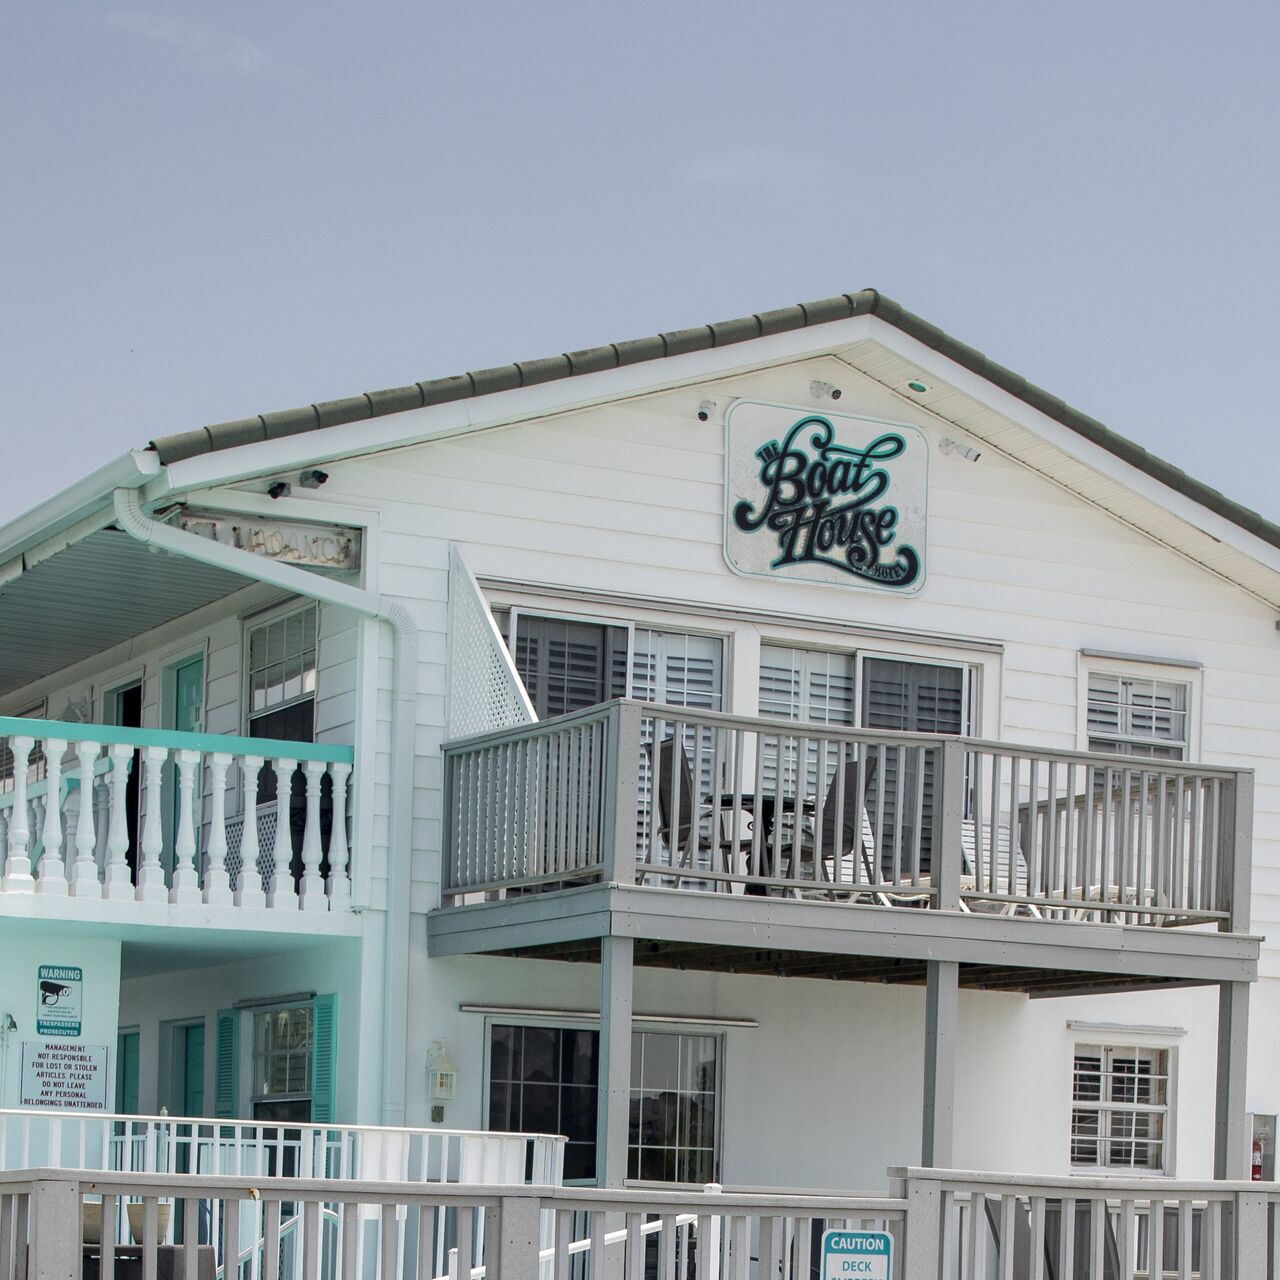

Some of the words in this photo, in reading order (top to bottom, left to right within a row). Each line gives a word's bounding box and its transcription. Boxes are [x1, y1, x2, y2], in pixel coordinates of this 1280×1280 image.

[757, 442, 780, 463] THE
[40, 968, 80, 980] WARNING
[39, 1020, 80, 1028] TRESPASSERS
[39, 1028, 78, 1036] PROSECUTED
[45, 1044, 85, 1052] MANAGEMENT
[52, 1054, 92, 1062] RESPONSIBLE
[64, 1100, 103, 1108] UNATTENDED
[831, 1237, 884, 1251] CAUTION
[842, 1261, 872, 1272] DECK
